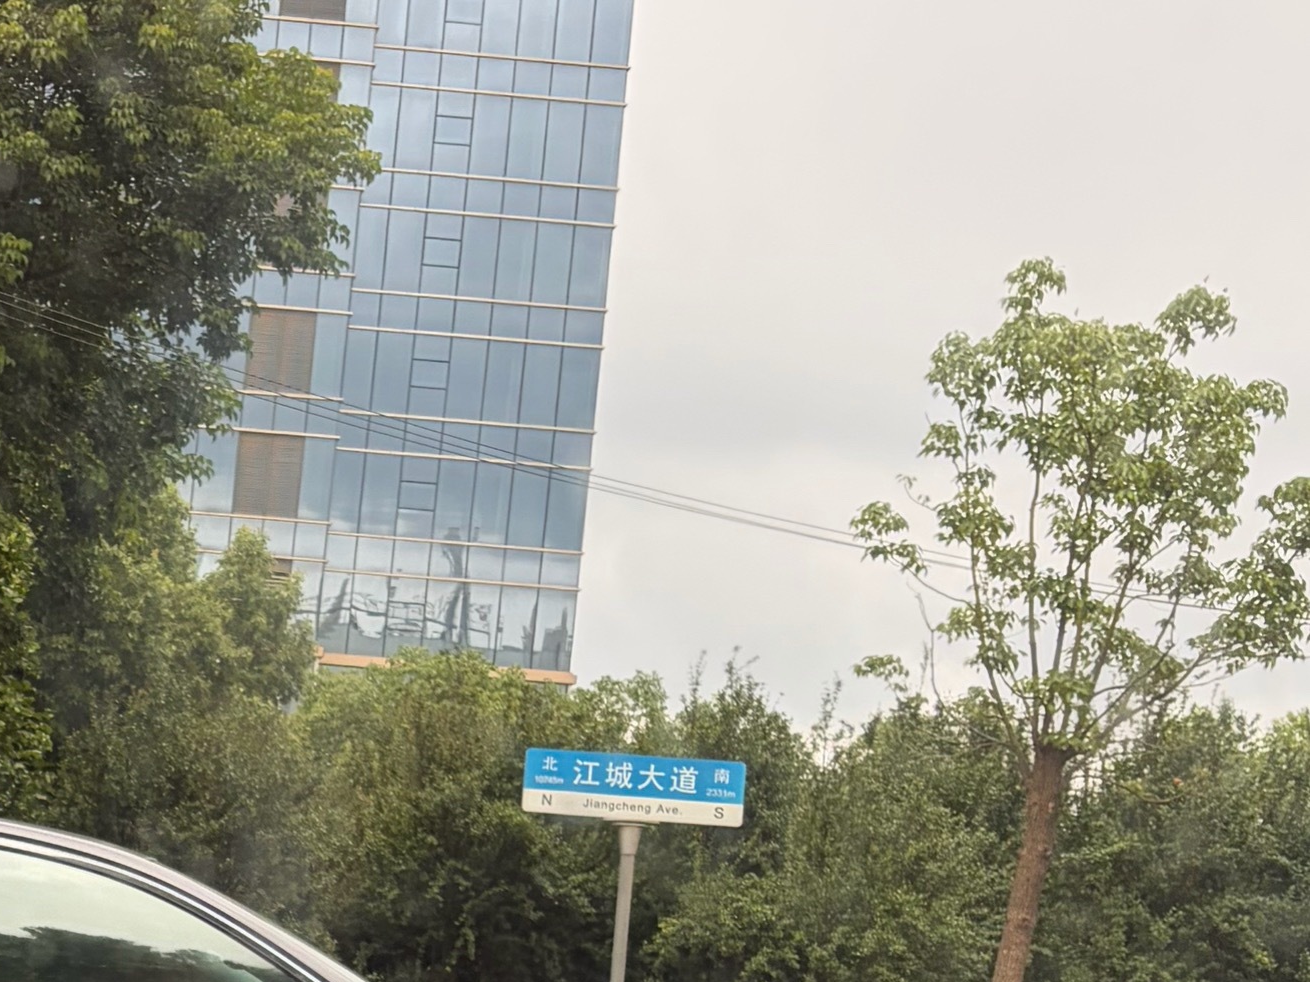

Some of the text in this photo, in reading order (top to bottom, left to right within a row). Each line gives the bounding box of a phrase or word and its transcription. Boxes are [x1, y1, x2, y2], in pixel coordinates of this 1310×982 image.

[542, 756, 559, 772] 北
[572, 758, 699, 795] 江城大道
[714, 768, 730, 785] 南
[541, 794, 553, 807] N
[583, 798, 683, 816] Jiangcheng Ave.
[713, 806, 725, 820] S
